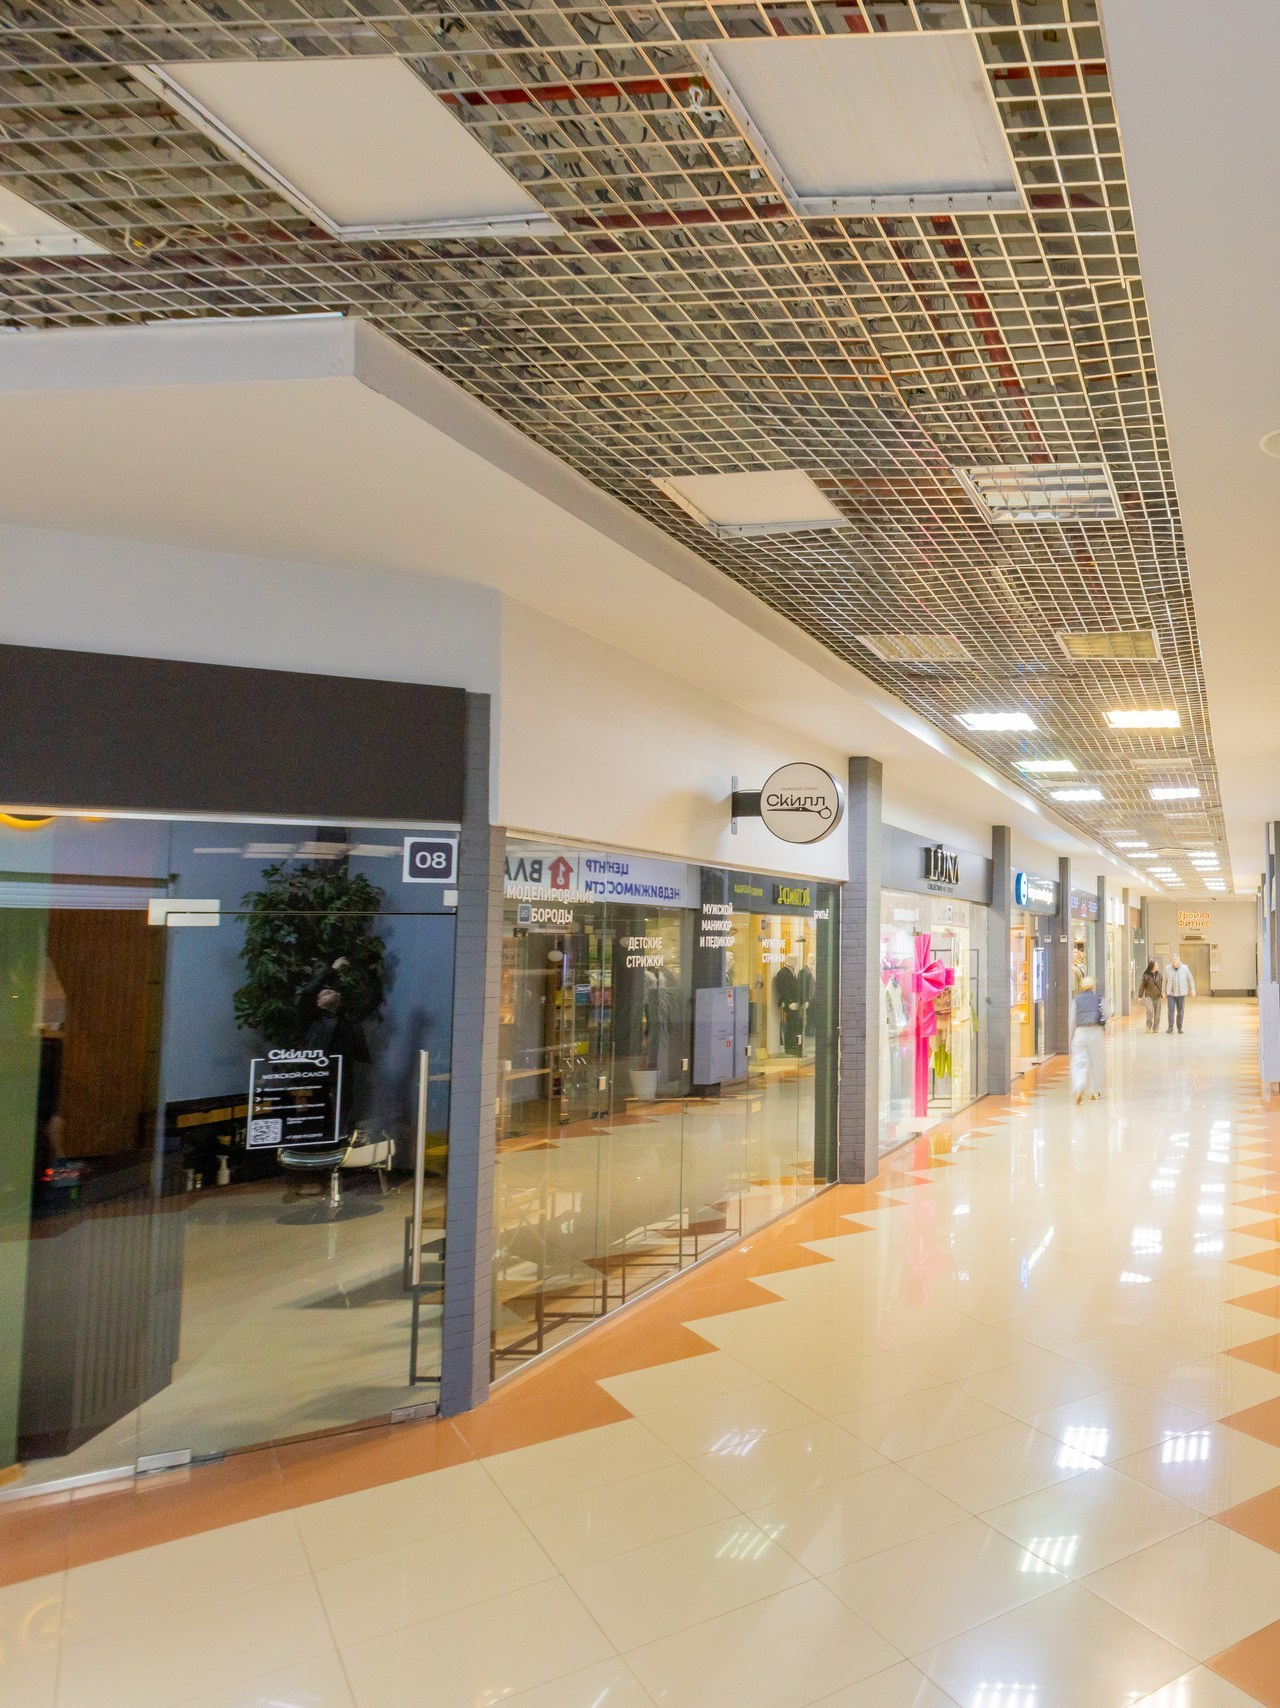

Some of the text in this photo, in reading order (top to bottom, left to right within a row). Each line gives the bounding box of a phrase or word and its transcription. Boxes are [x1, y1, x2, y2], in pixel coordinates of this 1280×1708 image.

[415, 851, 447, 869] 08
[506, 884, 595, 905] МОДЕЛИРОВАНИЕ
[703, 902, 733, 915] МУЖСКОЙ
[531, 908, 573, 925] БОРОДЫ
[1178, 911, 1210, 920] Тройка
[702, 920, 732, 931] МАНИКЮР
[628, 936, 663, 951] ДЕТСКИЕ
[700, 936, 735, 949] И ПЕДИКЮР
[626, 955, 664, 968] СТРИЖКИ
[762, 953, 786, 963] СТРИЖКИ
